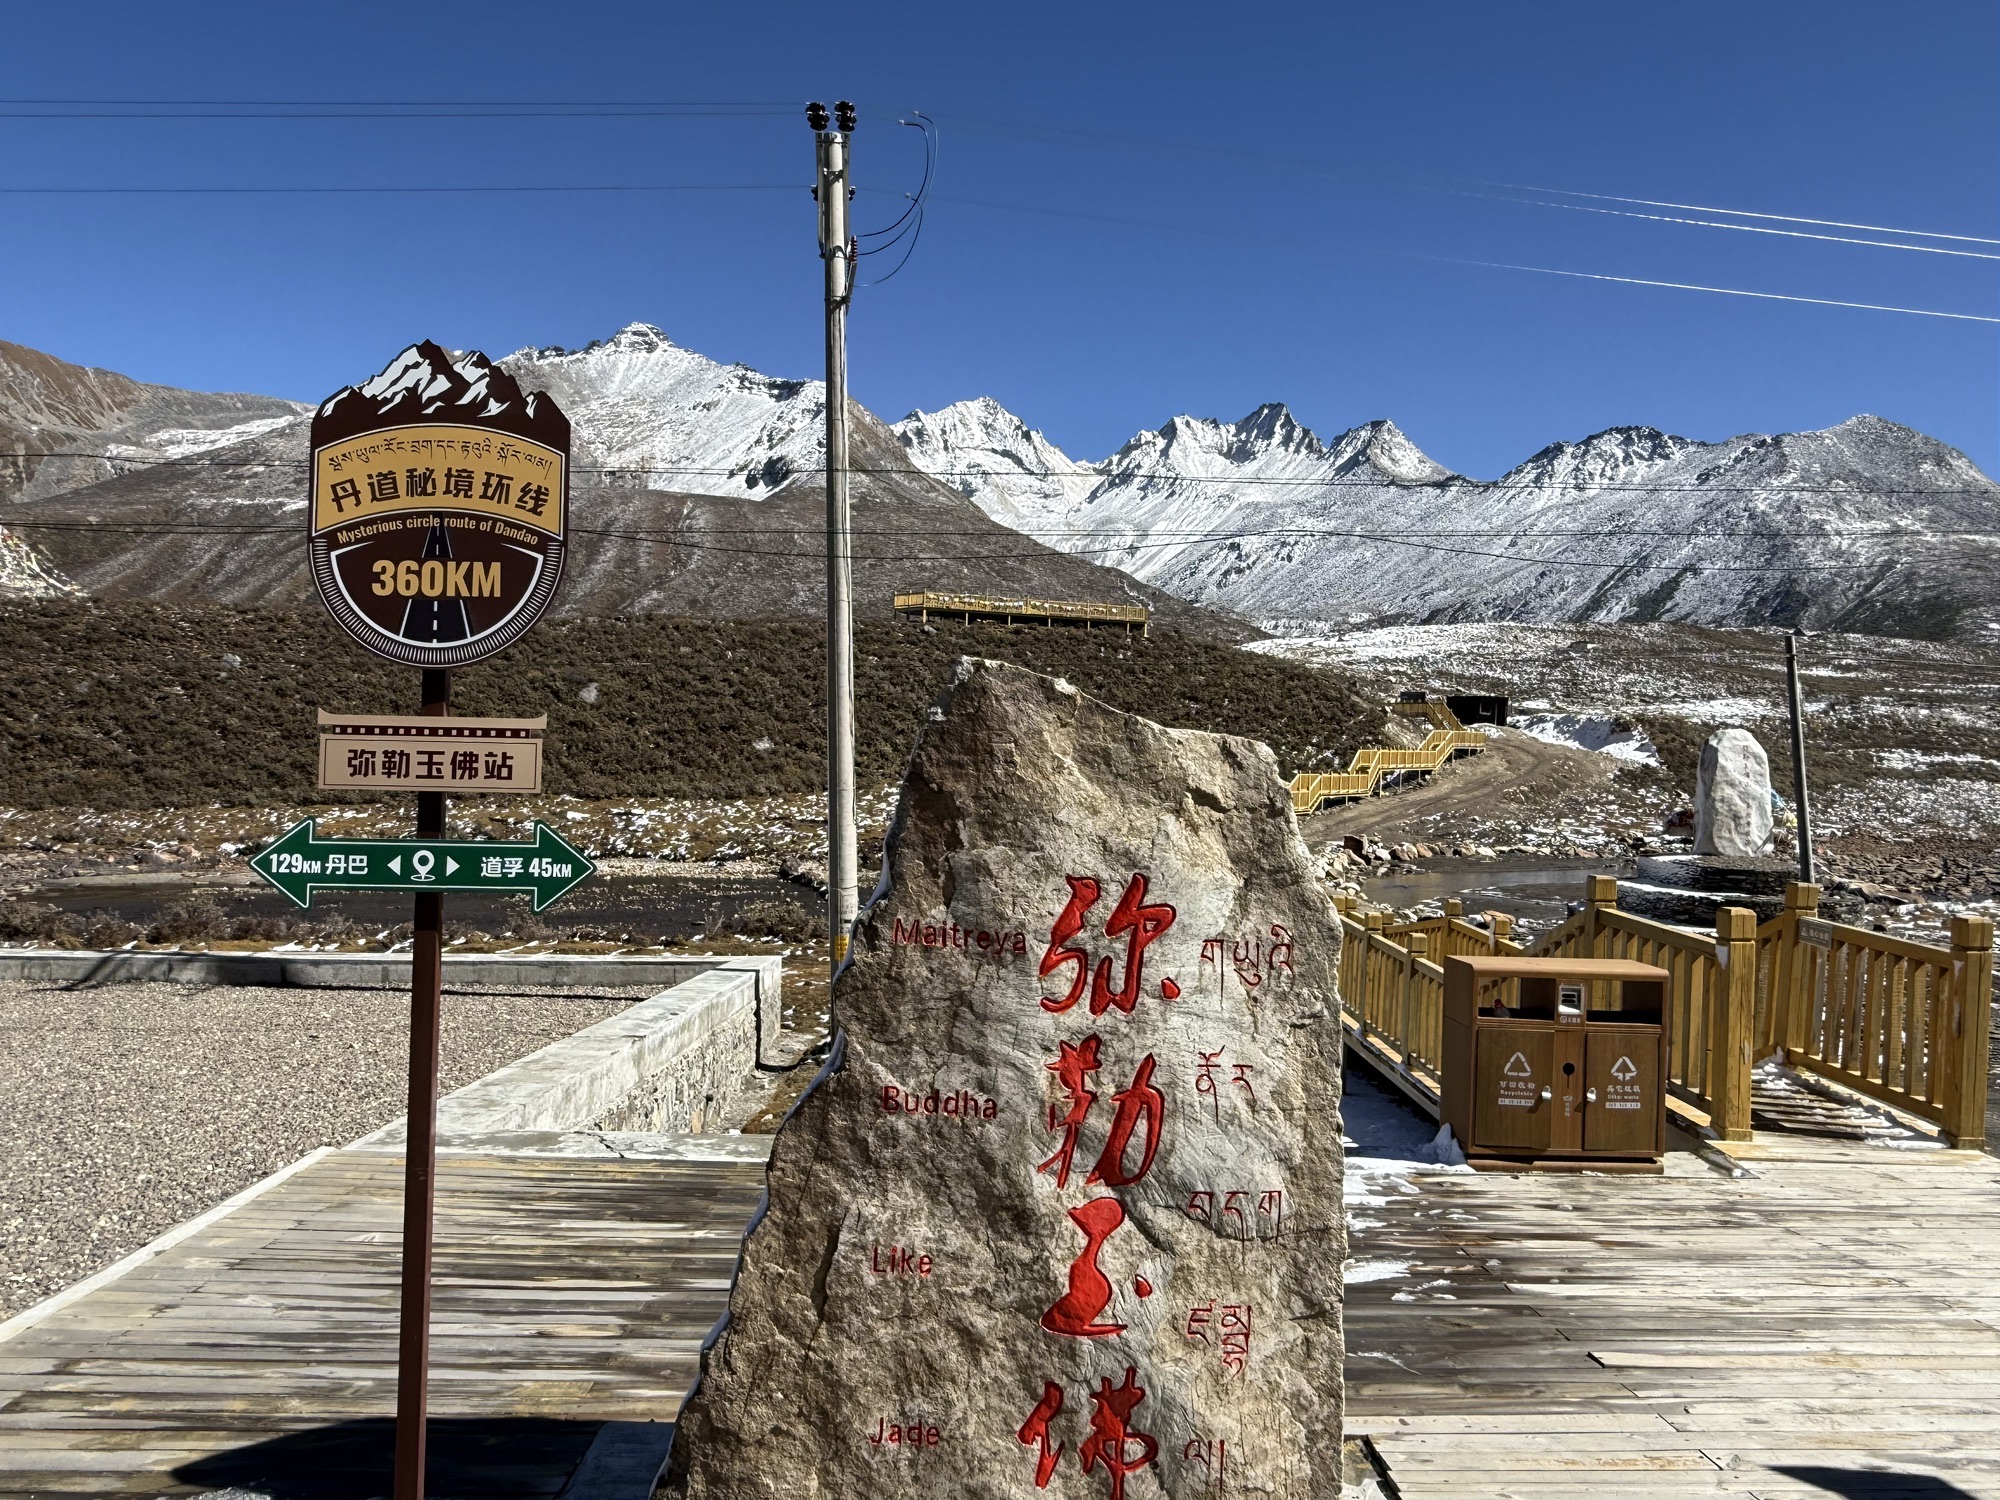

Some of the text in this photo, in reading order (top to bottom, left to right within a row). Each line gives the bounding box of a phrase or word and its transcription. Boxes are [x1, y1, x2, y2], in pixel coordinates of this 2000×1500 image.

[330, 467, 550, 517] 丹道秘境环线
[336, 514, 539, 545] Mysterious circle route of Dandao
[371, 560, 502, 598] 360KM
[347, 748, 514, 781] 弥勒玉佛站
[325, 854, 368, 875] 丹巴
[480, 857, 524, 878] 道孚
[892, 918, 1027, 958] Maitreya
[1499, 1081, 1536, 1089] 可回收物
[882, 1085, 998, 1120] Buddha
[871, 1246, 933, 1276] Like
[870, 1416, 941, 1448] Jade
